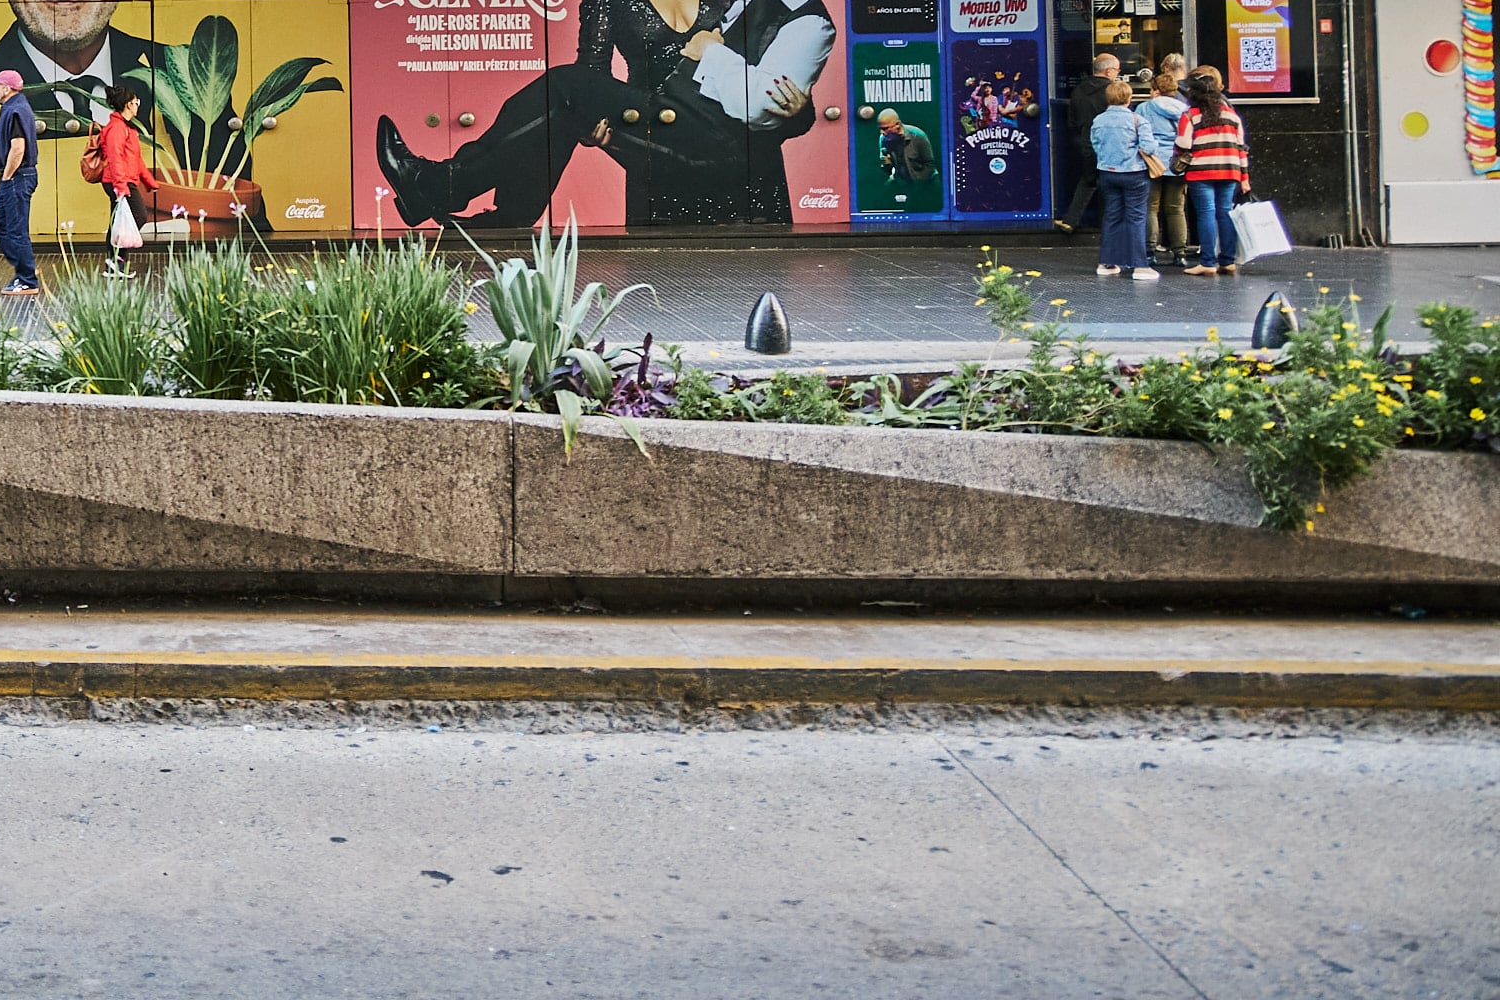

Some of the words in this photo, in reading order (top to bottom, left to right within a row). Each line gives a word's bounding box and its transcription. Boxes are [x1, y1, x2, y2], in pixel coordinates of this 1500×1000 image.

[868, 6, 876, 14] 13
[876, 6, 893, 14] AÑOS
[959, 0, 1001, 16] MODELO
[415, 14, 480, 31] JADE-ROSE
[481, 14, 531, 30] PARKER
[968, 13, 1018, 29] MUERTO
[432, 34, 479, 51] NELSON
[481, 33, 533, 50] VALENTE
[406, 61, 431, 72] PAULA
[433, 61, 459, 72] KOHAN
[463, 61, 484, 71] ARIEL
[485, 58, 508, 71] PÉREZ
[509, 60, 519, 71] DE
[520, 58, 546, 71] MARÍA
[890, 62, 931, 78] SEBASTIÁN
[863, 79, 932, 103] WAINRAICH
[965, 126, 1009, 148] PEQUEÑO
[1010, 130, 1030, 148] PEZ
